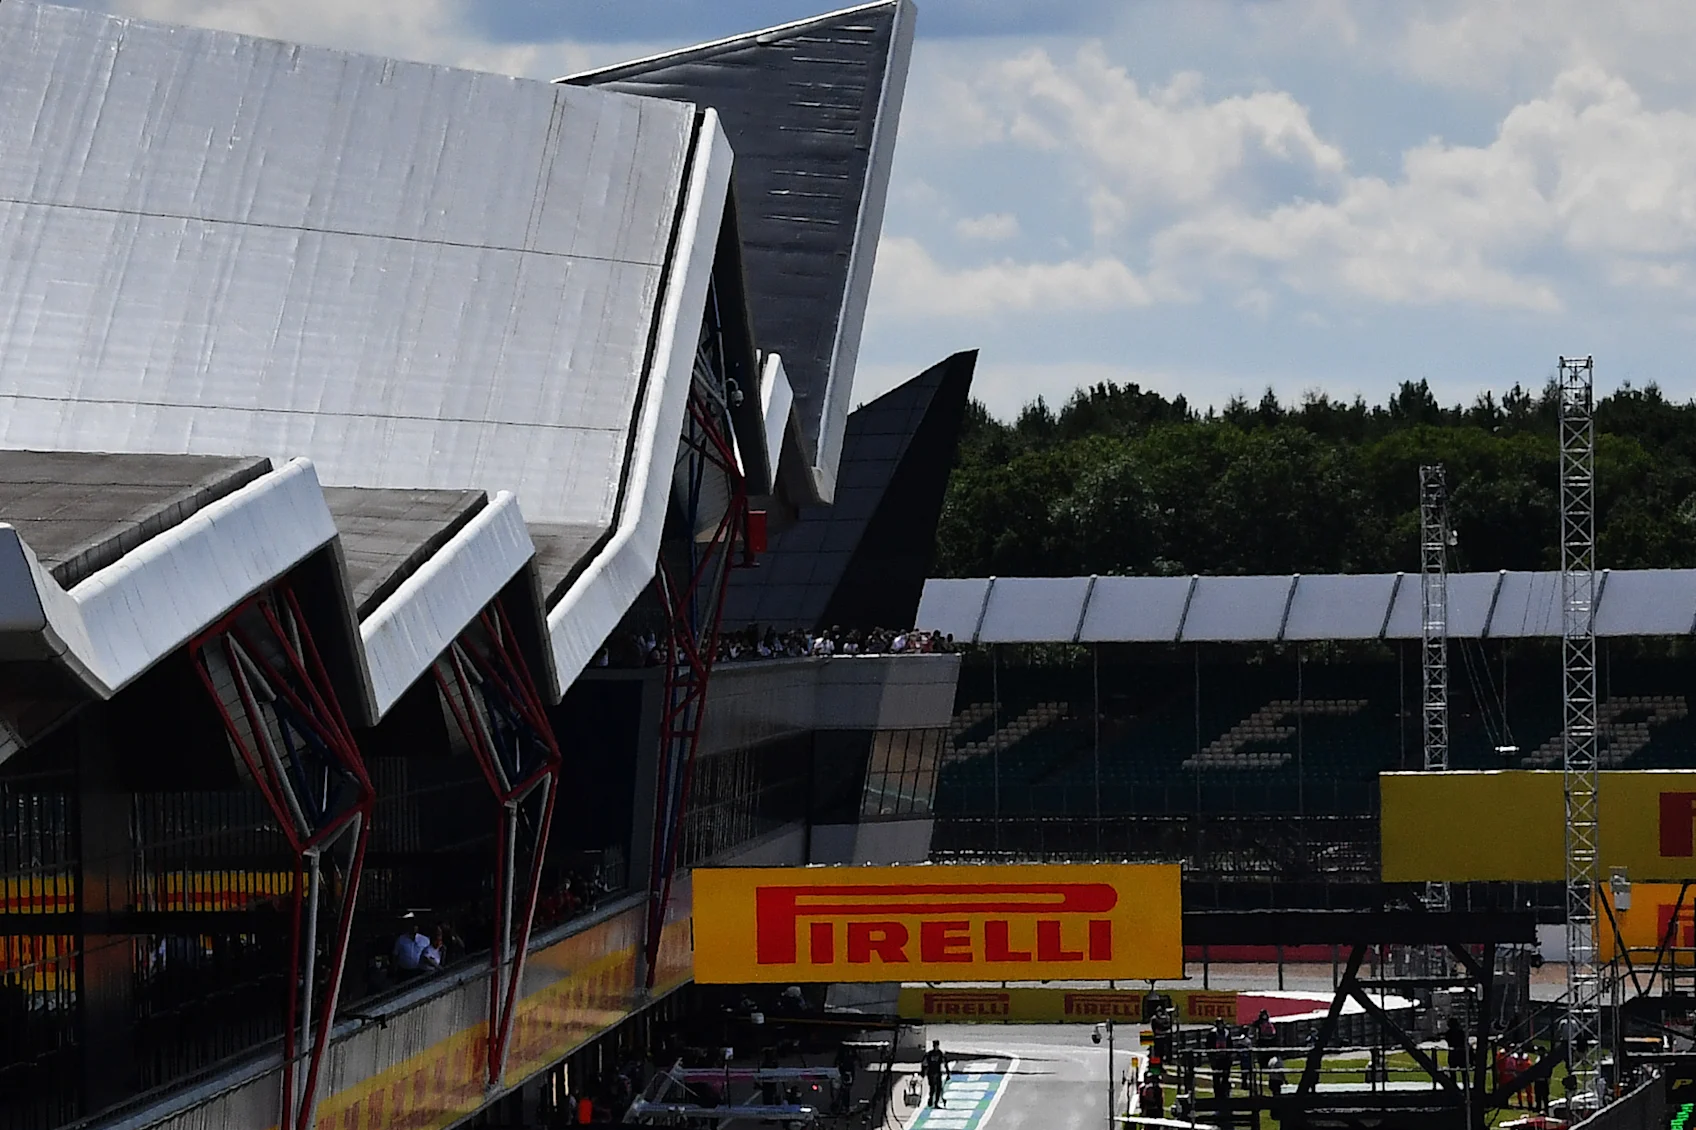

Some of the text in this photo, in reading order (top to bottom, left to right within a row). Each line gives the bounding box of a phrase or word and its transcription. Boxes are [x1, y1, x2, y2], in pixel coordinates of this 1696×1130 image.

[756, 884, 1118, 964] PIRELLI
[924, 993, 1010, 1015] PIRELLI
[1064, 994, 1141, 1016] PIRELLI
[1672, 1078, 1693, 1091] P
